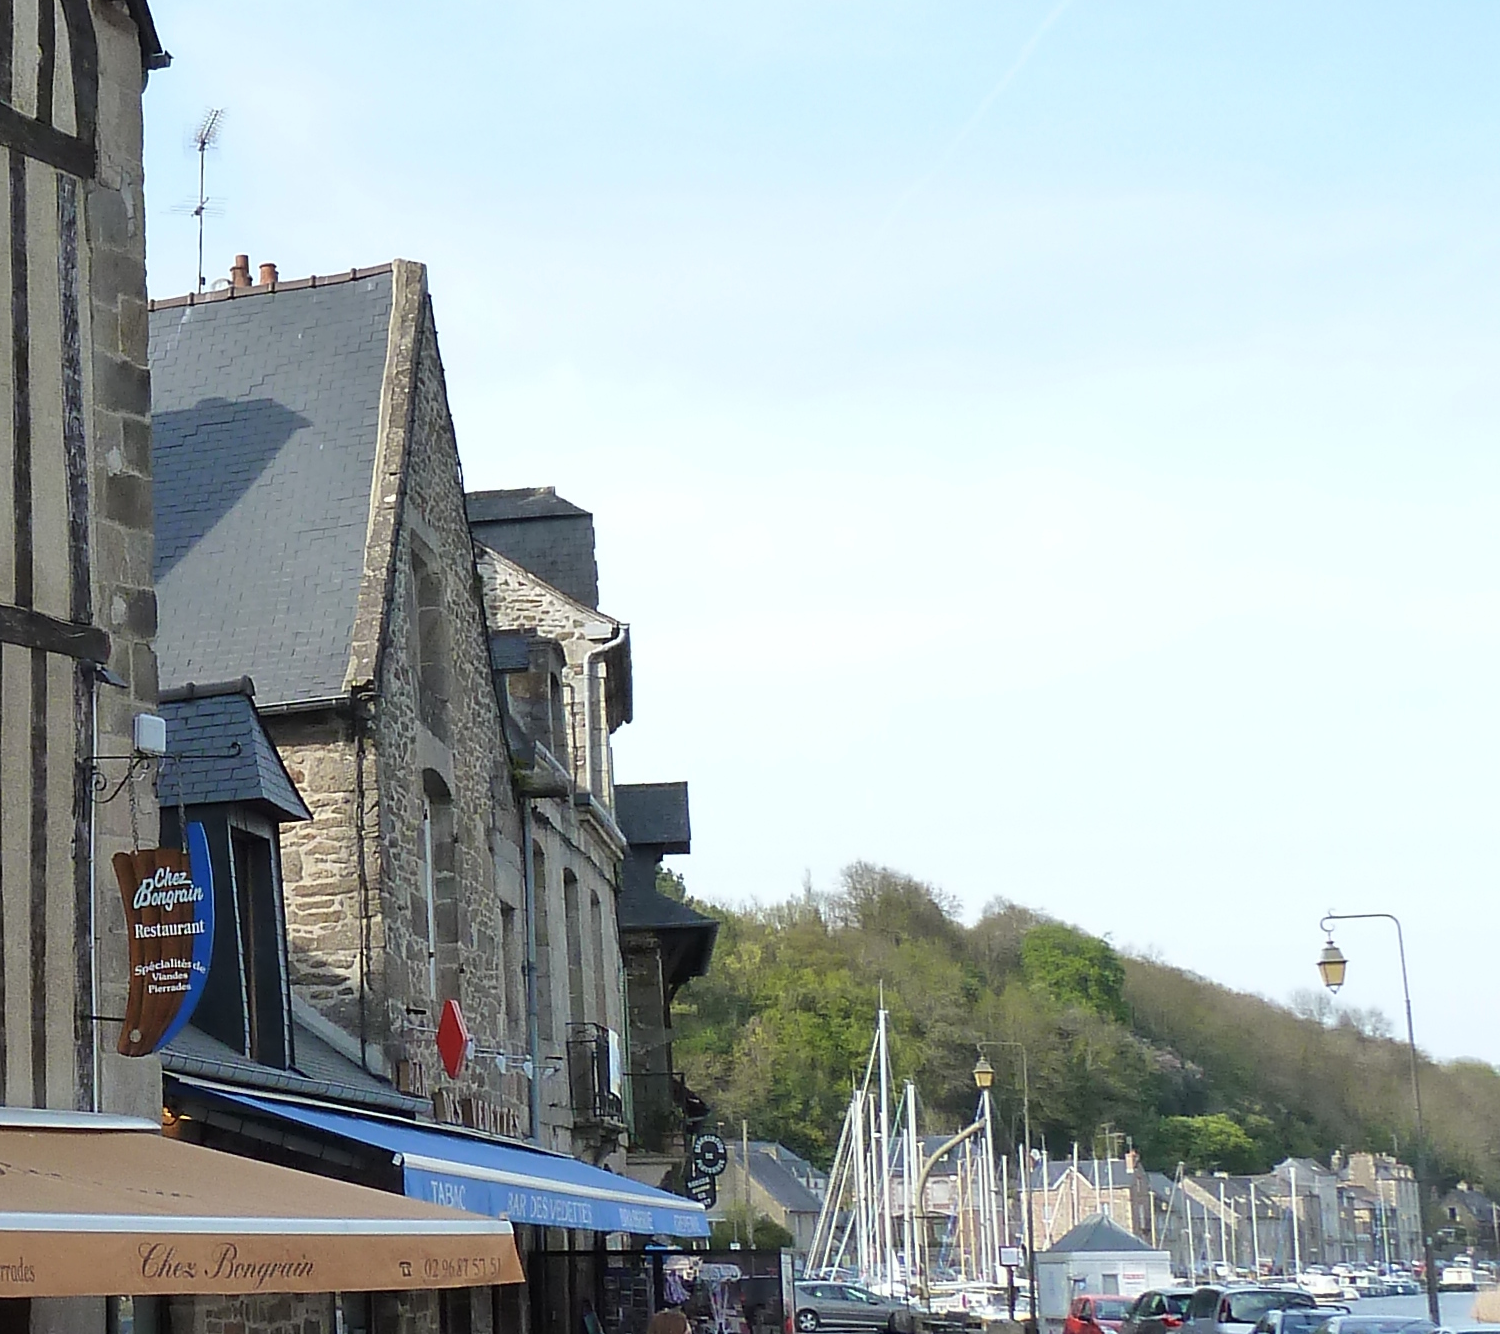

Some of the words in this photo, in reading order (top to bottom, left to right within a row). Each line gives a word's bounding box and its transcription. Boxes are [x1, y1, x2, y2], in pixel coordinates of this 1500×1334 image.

[154, 866, 192, 888] Chez
[133, 877, 204, 911] Bongrain
[134, 919, 205, 939] Restaurant
[134, 958, 192, 976] Spécialités
[192, 961, 206, 974] de
[152, 970, 188, 981] Viandes
[148, 982, 192, 994] Pierrades
[429, 1180, 466, 1211] TABAC
[507, 1191, 526, 1217] BAR
[530, 1195, 547, 1219] DES
[548, 1198, 592, 1224] VEDETTES
[138, 1242, 197, 1279] Chez
[204, 1242, 315, 1288] Bongrain
[424, 1257, 439, 1278] 02
